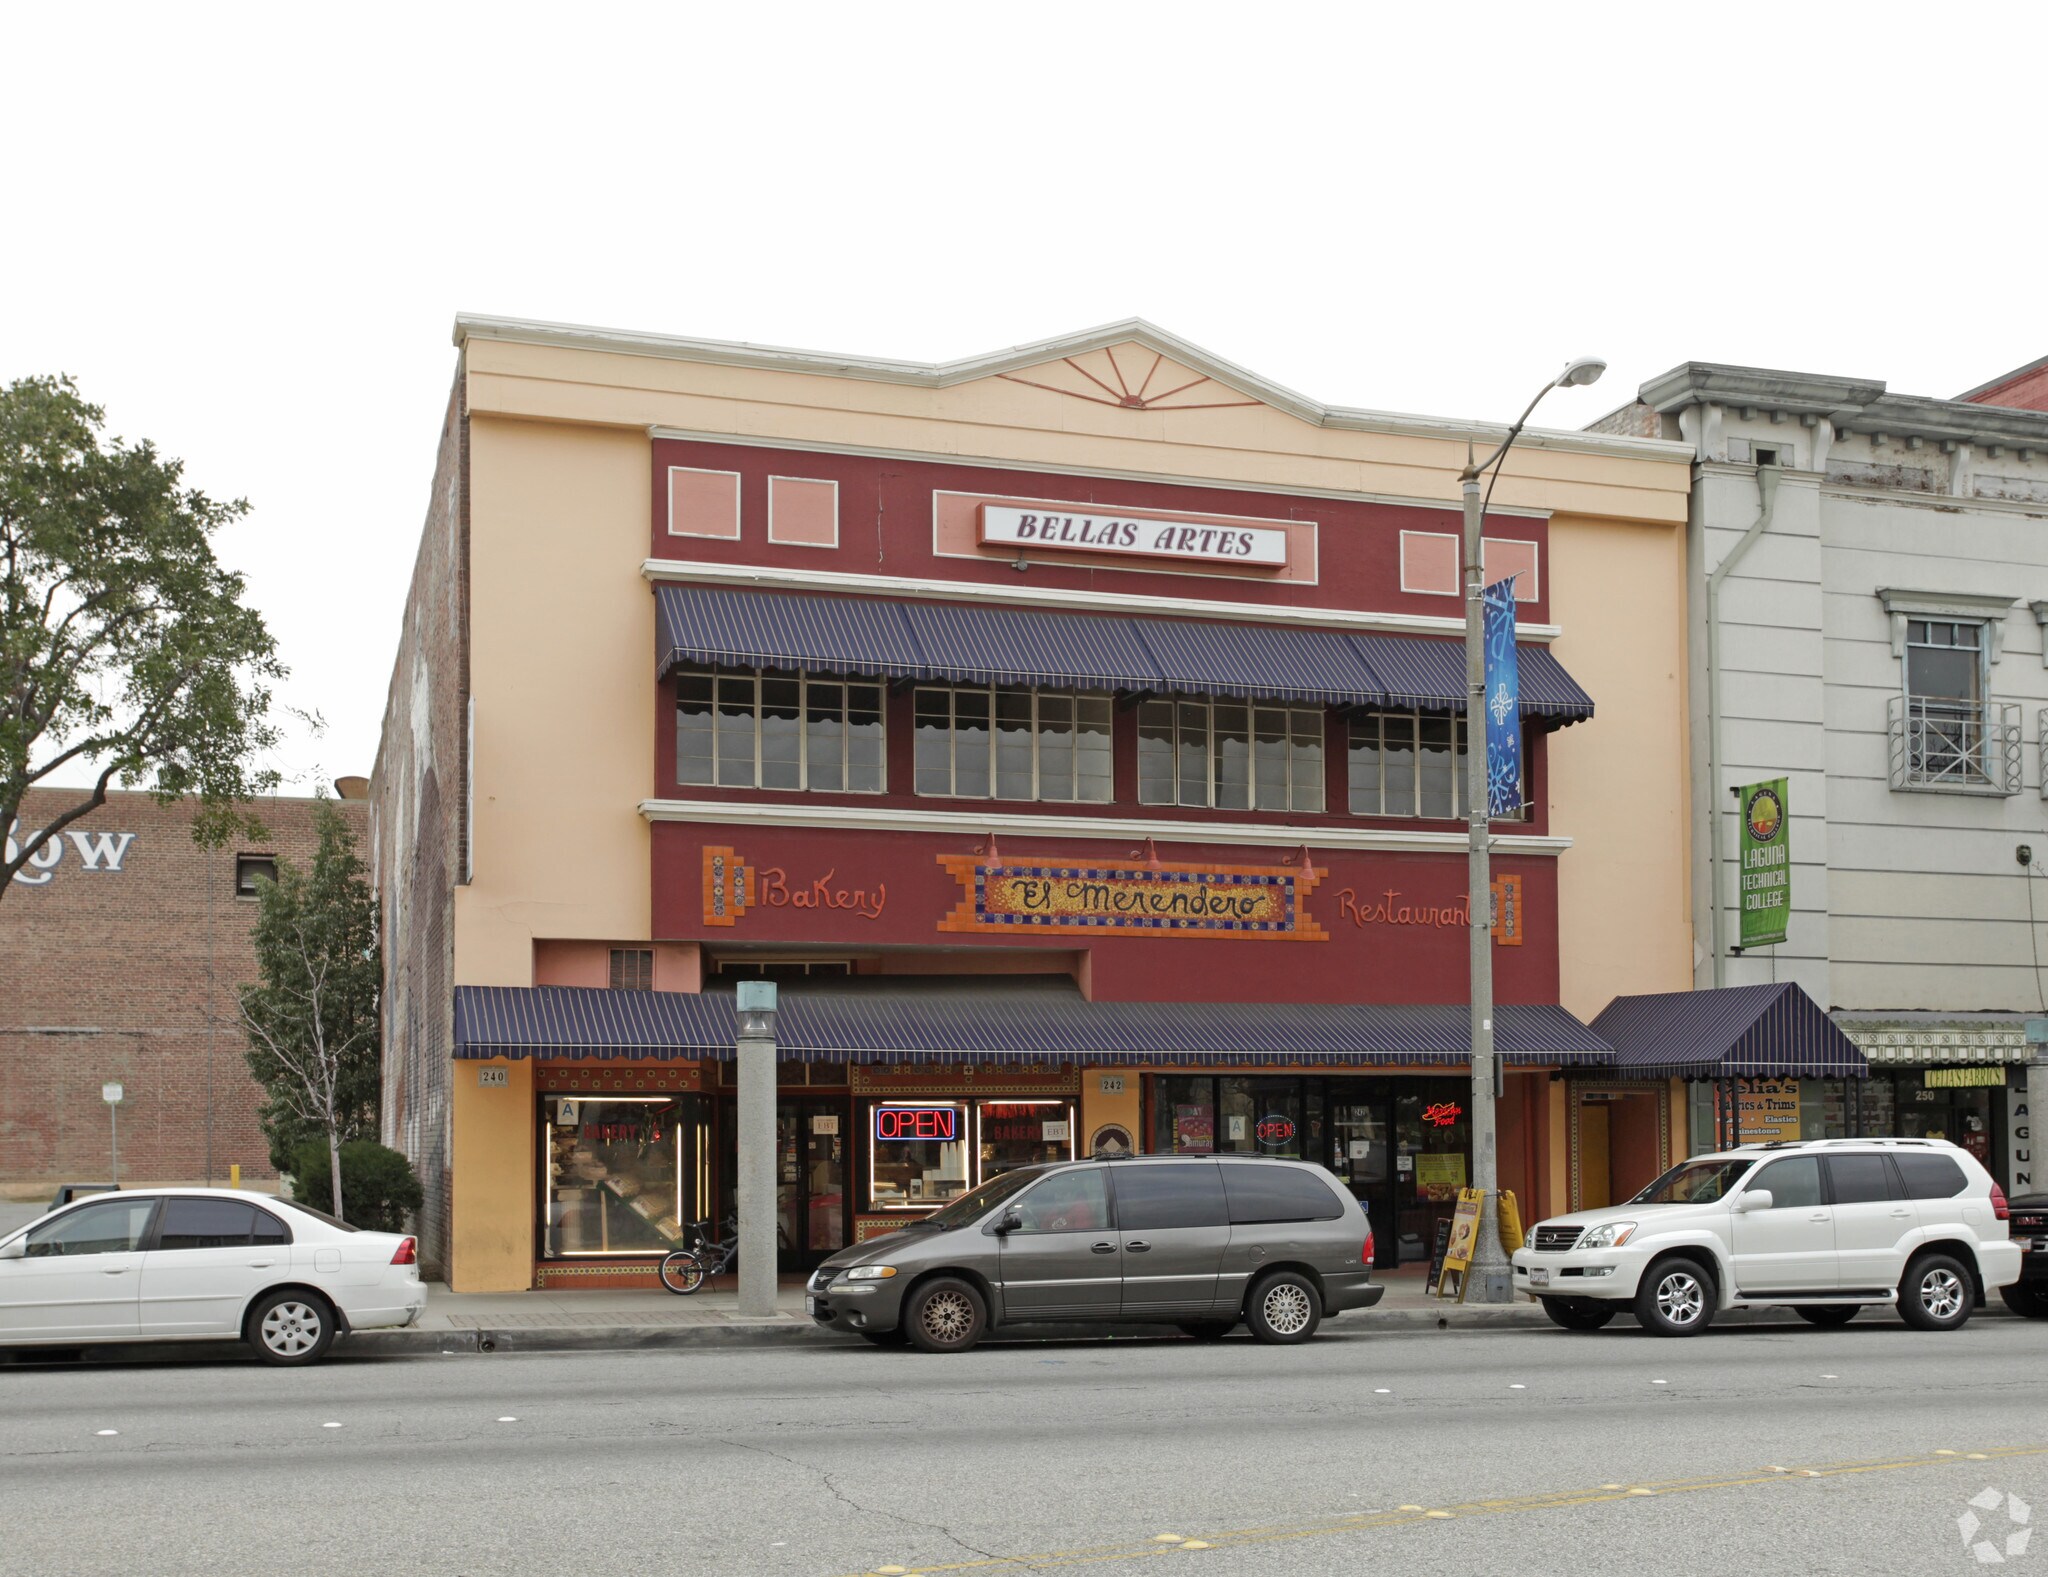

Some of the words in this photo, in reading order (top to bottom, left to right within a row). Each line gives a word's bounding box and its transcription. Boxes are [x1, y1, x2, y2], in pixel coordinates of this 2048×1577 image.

[1016, 513, 1139, 547] BELLAS
[1153, 526, 1255, 556] ARTES
[1743, 844, 1786, 869] LAGUNA
[1742, 869, 1788, 891] TECHNICAL
[1011, 879, 1051, 910] El
[1066, 884, 1266, 919] Merendero
[1746, 890, 1784, 910] COLLEGE
[483, 1072, 504, 1082] 240
[1963, 1067, 2001, 1087] FABRICS
[1104, 1080, 1122, 1090] 242
[1915, 1091, 1935, 1101] 250
[562, 1103, 574, 1116] A
[1757, 1101, 1763, 1110] &
[1765, 1099, 1796, 1110] Trims
[879, 1111, 953, 1138] OPEN
[1433, 1114, 1455, 1127] Food
[1764, 1115, 1797, 1123] Elastics
[583, 1124, 637, 1140] BAKERY
[1047, 1128, 1064, 1136] EBT
[1232, 1121, 1242, 1132] A
[1258, 1123, 1293, 1138] OPEN
[1730, 1127, 1781, 1135] inestones
[2016, 1216, 2043, 1226] GMC
